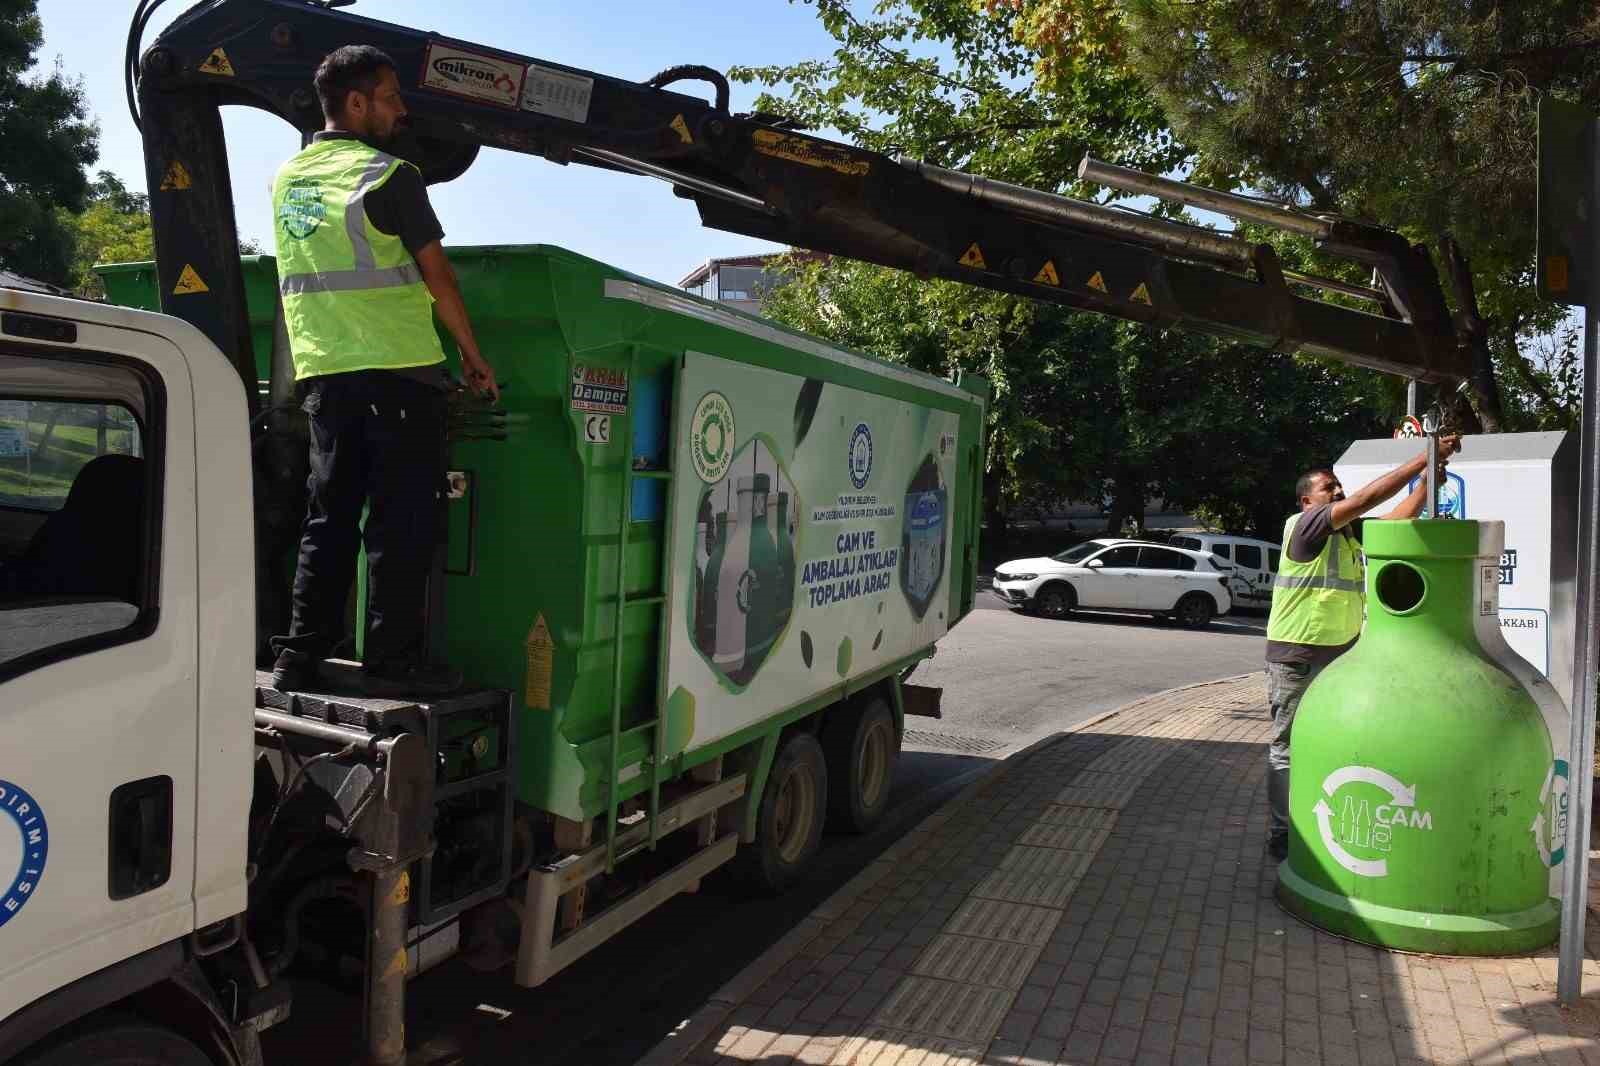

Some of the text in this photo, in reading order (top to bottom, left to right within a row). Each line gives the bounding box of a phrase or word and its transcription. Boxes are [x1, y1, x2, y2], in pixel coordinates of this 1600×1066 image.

[439, 61, 495, 82] mikron
[573, 384, 627, 404] Damper
[836, 530, 875, 554] CAM VE
[801, 548, 898, 585] AMBALAJ ATIKLARI
[1499, 553, 1516, 566] BI
[808, 572, 891, 608] TOPLAMA ARACI
[1498, 618, 1538, 629] AKKABI
[1375, 804, 1433, 831] CAM
